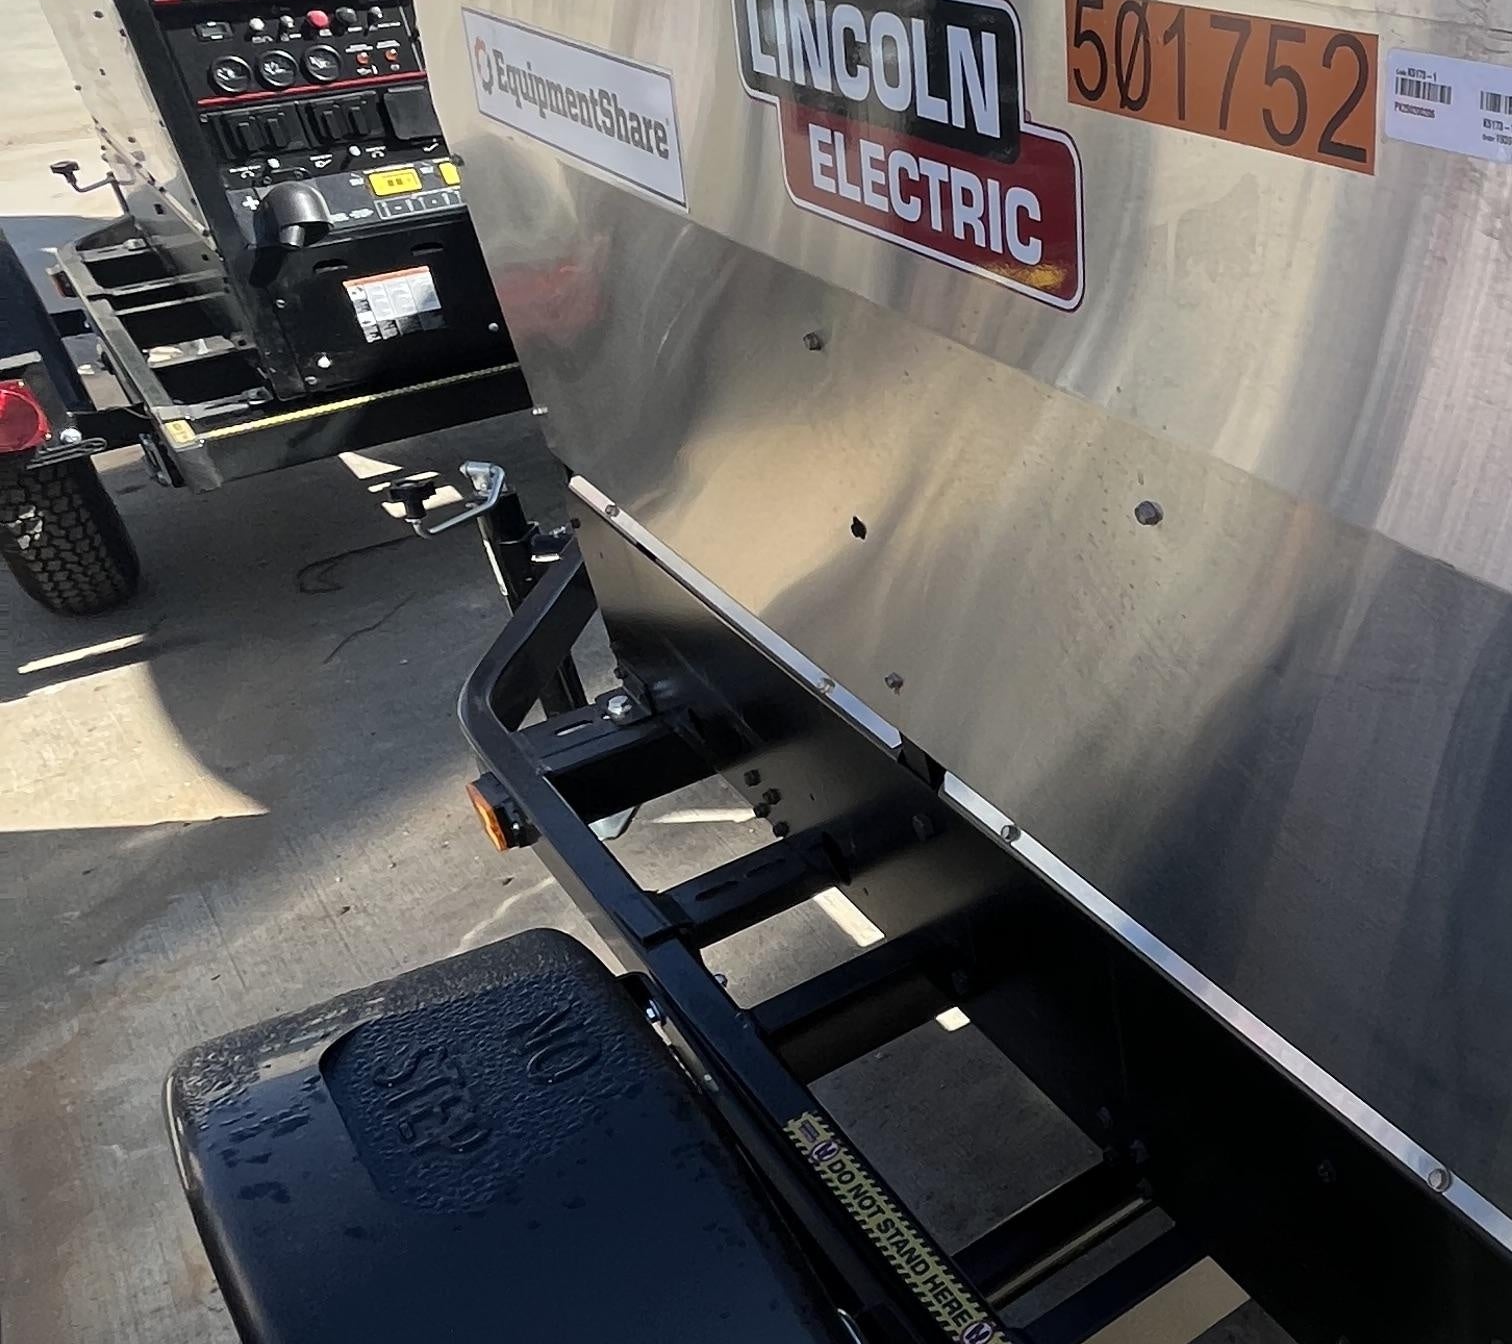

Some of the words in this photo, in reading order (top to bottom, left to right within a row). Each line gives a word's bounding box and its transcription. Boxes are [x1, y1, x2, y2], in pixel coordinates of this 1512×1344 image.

[492, 48, 670, 160] EquipmentShare
[807, 122, 1044, 265] ELECTRIC
[372, 1042, 494, 1154] STEP
[828, 1159, 855, 1185] DO
[850, 1183, 886, 1220] NOT
[877, 1218, 931, 1277] STAND
[923, 1273, 974, 1328] HERE
